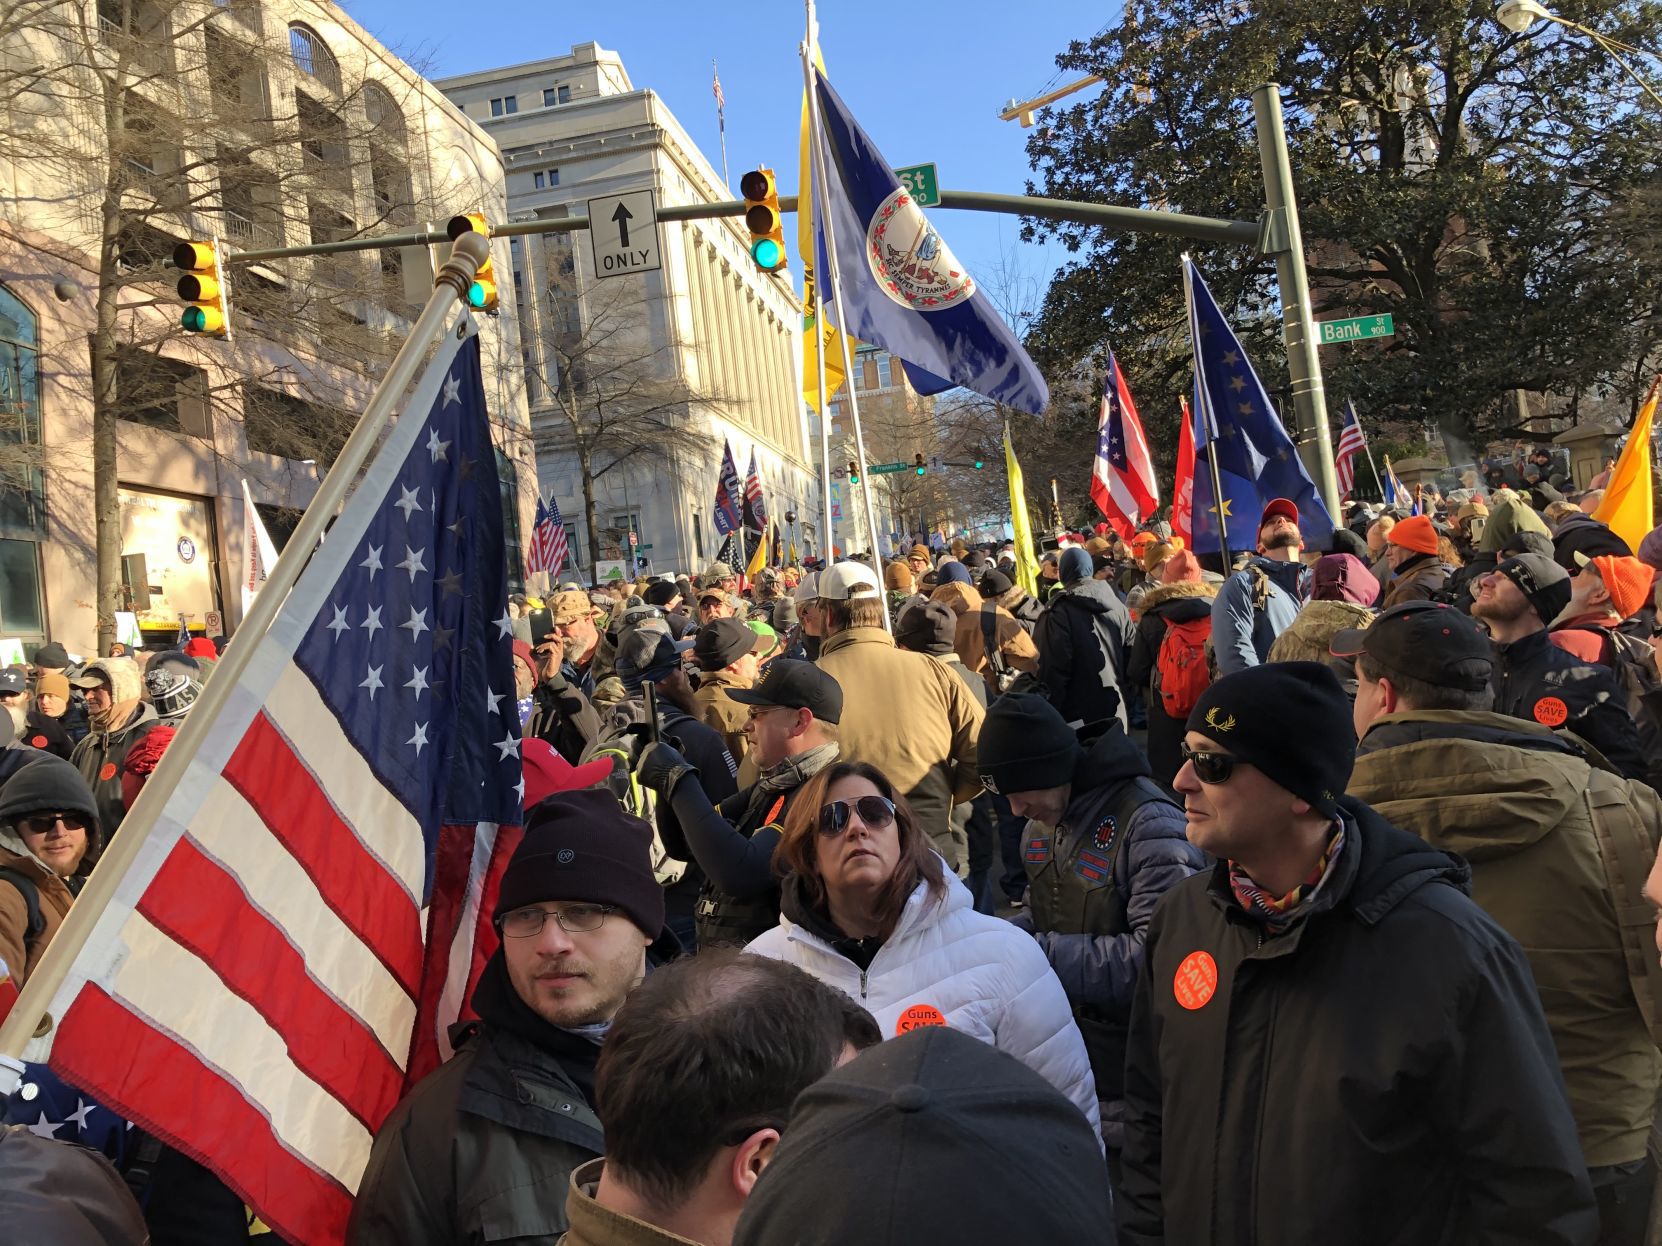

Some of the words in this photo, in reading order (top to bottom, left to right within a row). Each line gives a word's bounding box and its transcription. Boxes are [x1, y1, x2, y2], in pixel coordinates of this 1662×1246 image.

[900, 171, 926, 191] St
[603, 249, 650, 270] ONLY
[885, 258, 894, 273] SIC
[891, 268, 914, 291] SEMPER
[916, 283, 952, 294] TYRANNIS
[1324, 322, 1362, 341] Bank
[1376, 317, 1385, 326] St
[1370, 326, 1386, 336] 900
[1537, 705, 1564, 718] SAVE
[1543, 699, 1562, 708] Guns
[1539, 714, 1558, 723] Lives
[1197, 954, 1215, 985] Guns
[1177, 975, 1194, 1006] Lives
[1183, 959, 1212, 1003] SAVE
[908, 1009, 937, 1019] Guns
